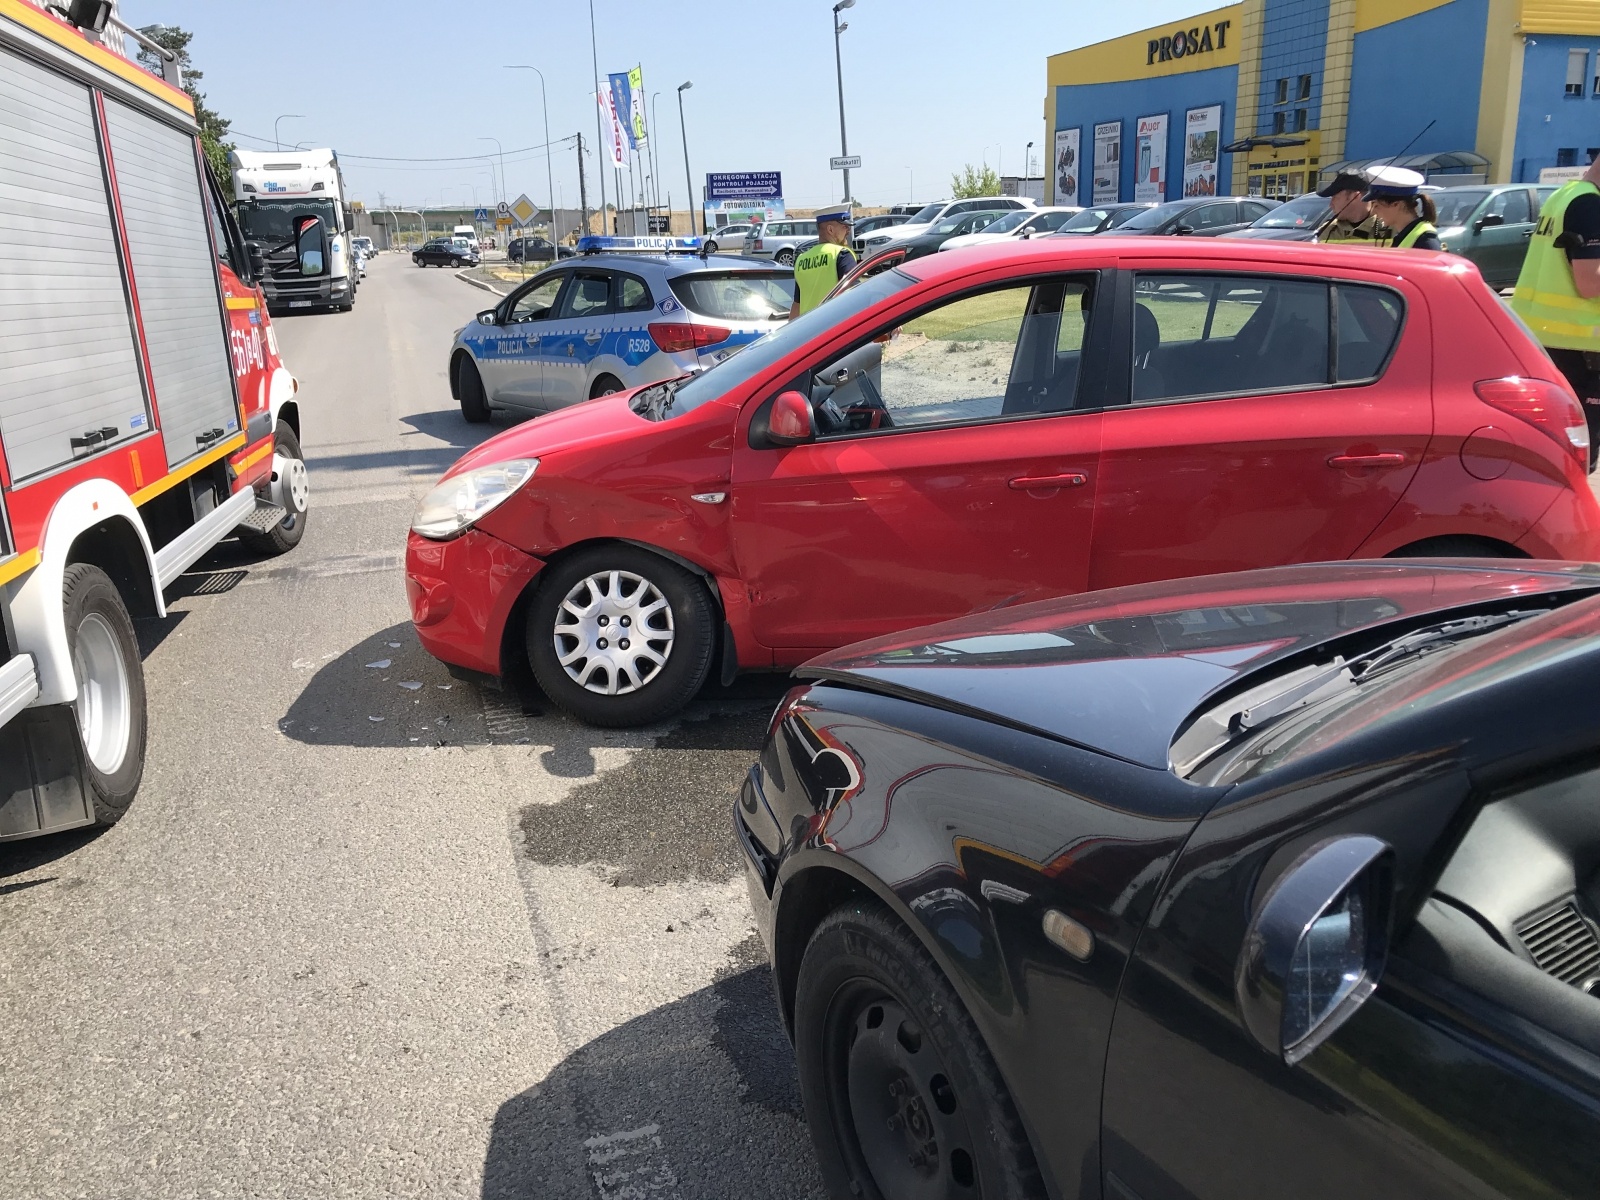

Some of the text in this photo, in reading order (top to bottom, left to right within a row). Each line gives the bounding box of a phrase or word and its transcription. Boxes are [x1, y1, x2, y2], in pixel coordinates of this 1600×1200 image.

[1146, 20, 1231, 65] PROSAT
[636, 238, 675, 248] POLICJA
[797, 254, 828, 272] POLICJA
[497, 340, 524, 355] POLICJA
[628, 338, 650, 353] R528
